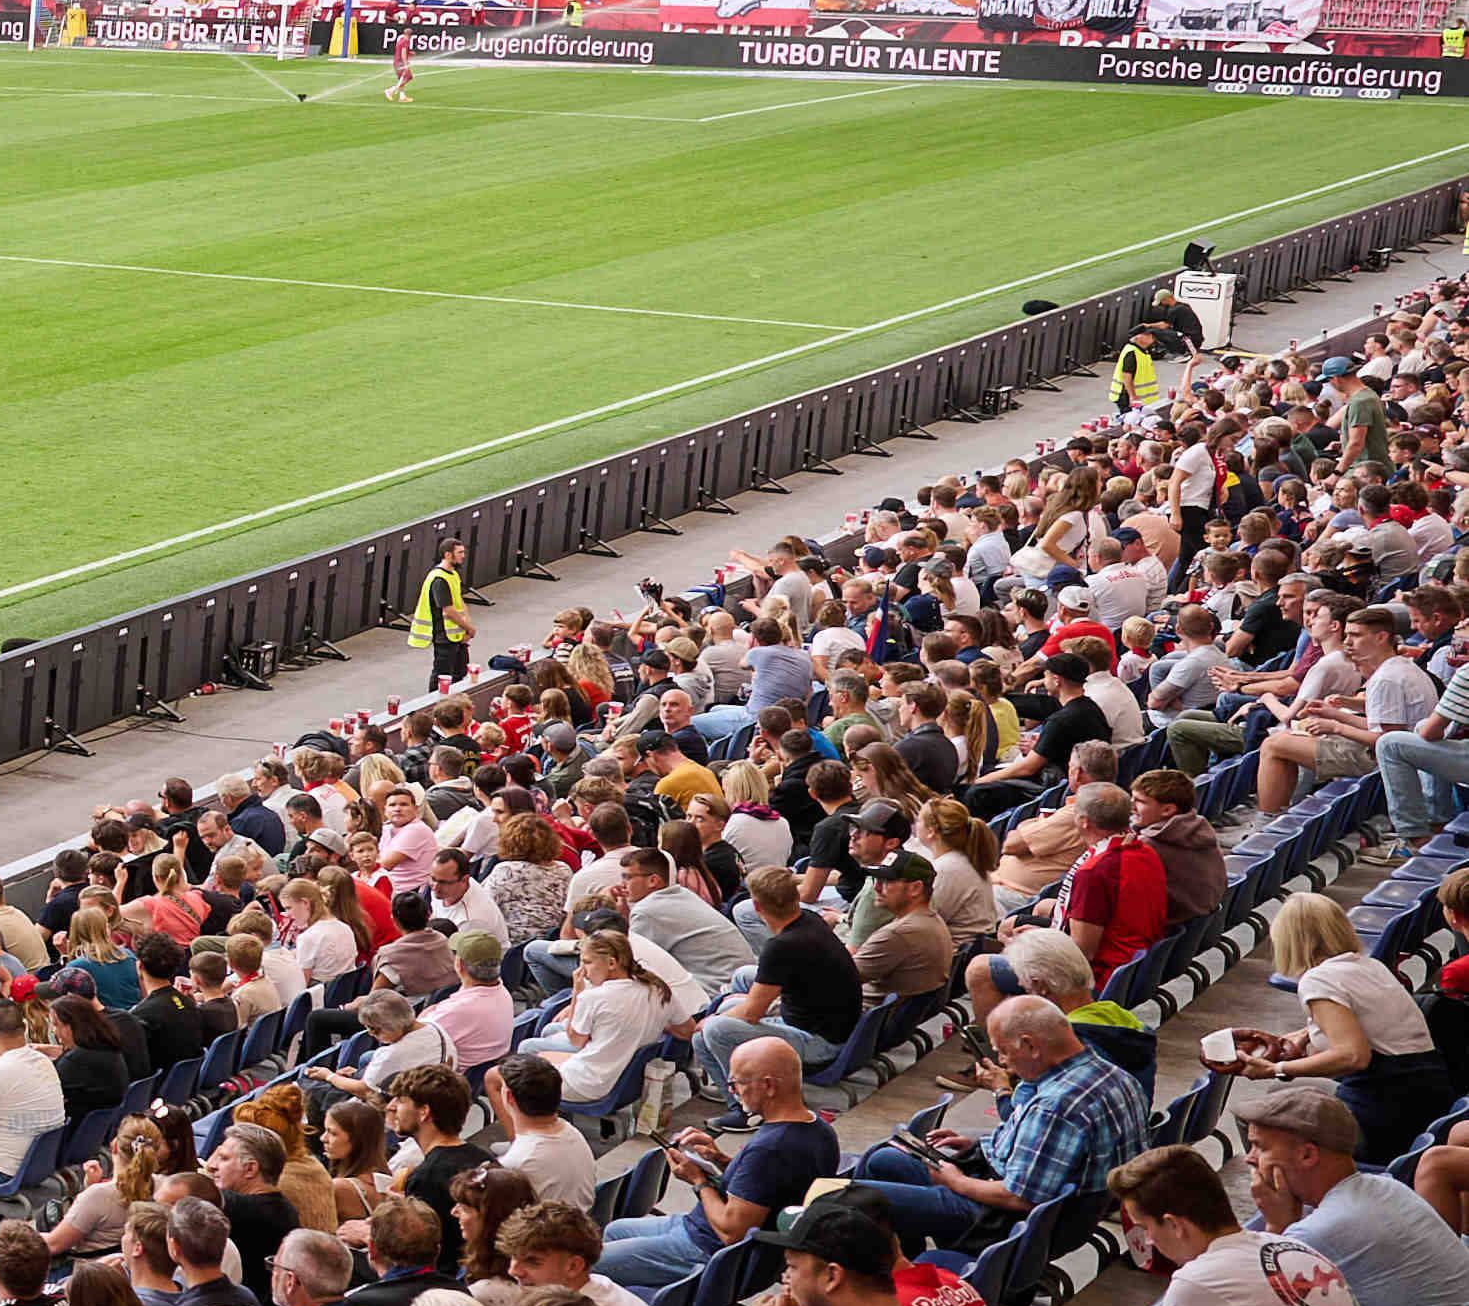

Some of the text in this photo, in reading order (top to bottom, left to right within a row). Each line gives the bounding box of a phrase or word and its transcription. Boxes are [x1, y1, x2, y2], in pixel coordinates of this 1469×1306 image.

[95, 19, 163, 40] TURBO
[170, 16, 208, 42] FÜR
[470, 34, 654, 63] Jugendförderung
[740, 40, 1001, 73] TURBO FÜR TALENTE
[1098, 54, 1443, 95] Porsche Jugendförderung
